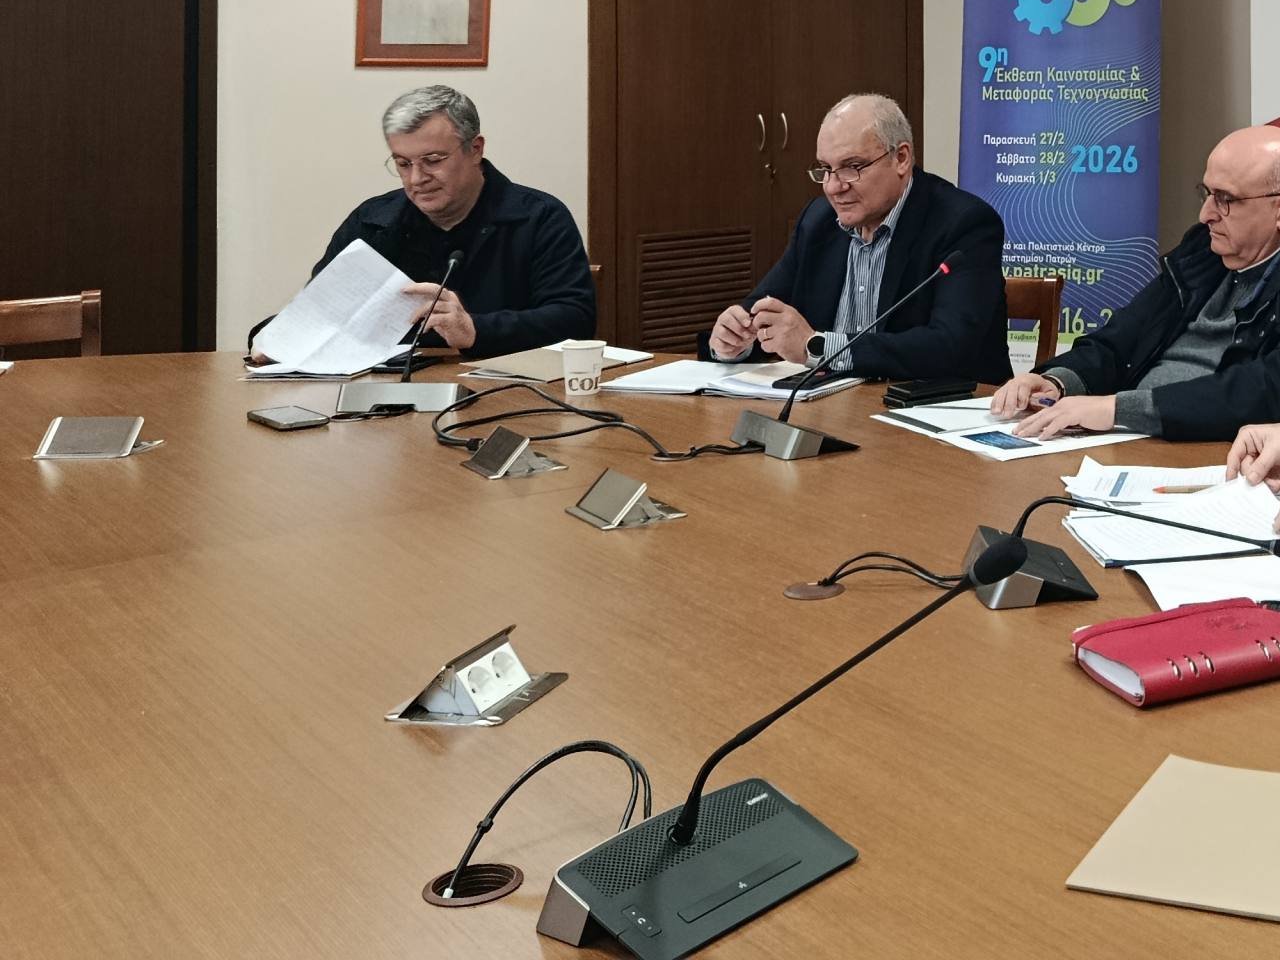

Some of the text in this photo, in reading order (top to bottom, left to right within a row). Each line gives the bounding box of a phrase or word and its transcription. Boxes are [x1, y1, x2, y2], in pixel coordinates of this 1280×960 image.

[994, 64, 1141, 84] Έκθεση Καινοτομίας &
[982, 83, 1053, 104] Μεταφοράς
[983, 131, 1064, 146] Παρασκευή 27/2
[996, 151, 1065, 166] Σάββατο 28/2
[1071, 145, 1138, 173] 2026
[996, 170, 1056, 185] Κυριακή 1/3
[1013, 242, 1026, 250] και
[1002, 253, 1044, 263] πιστημίου
